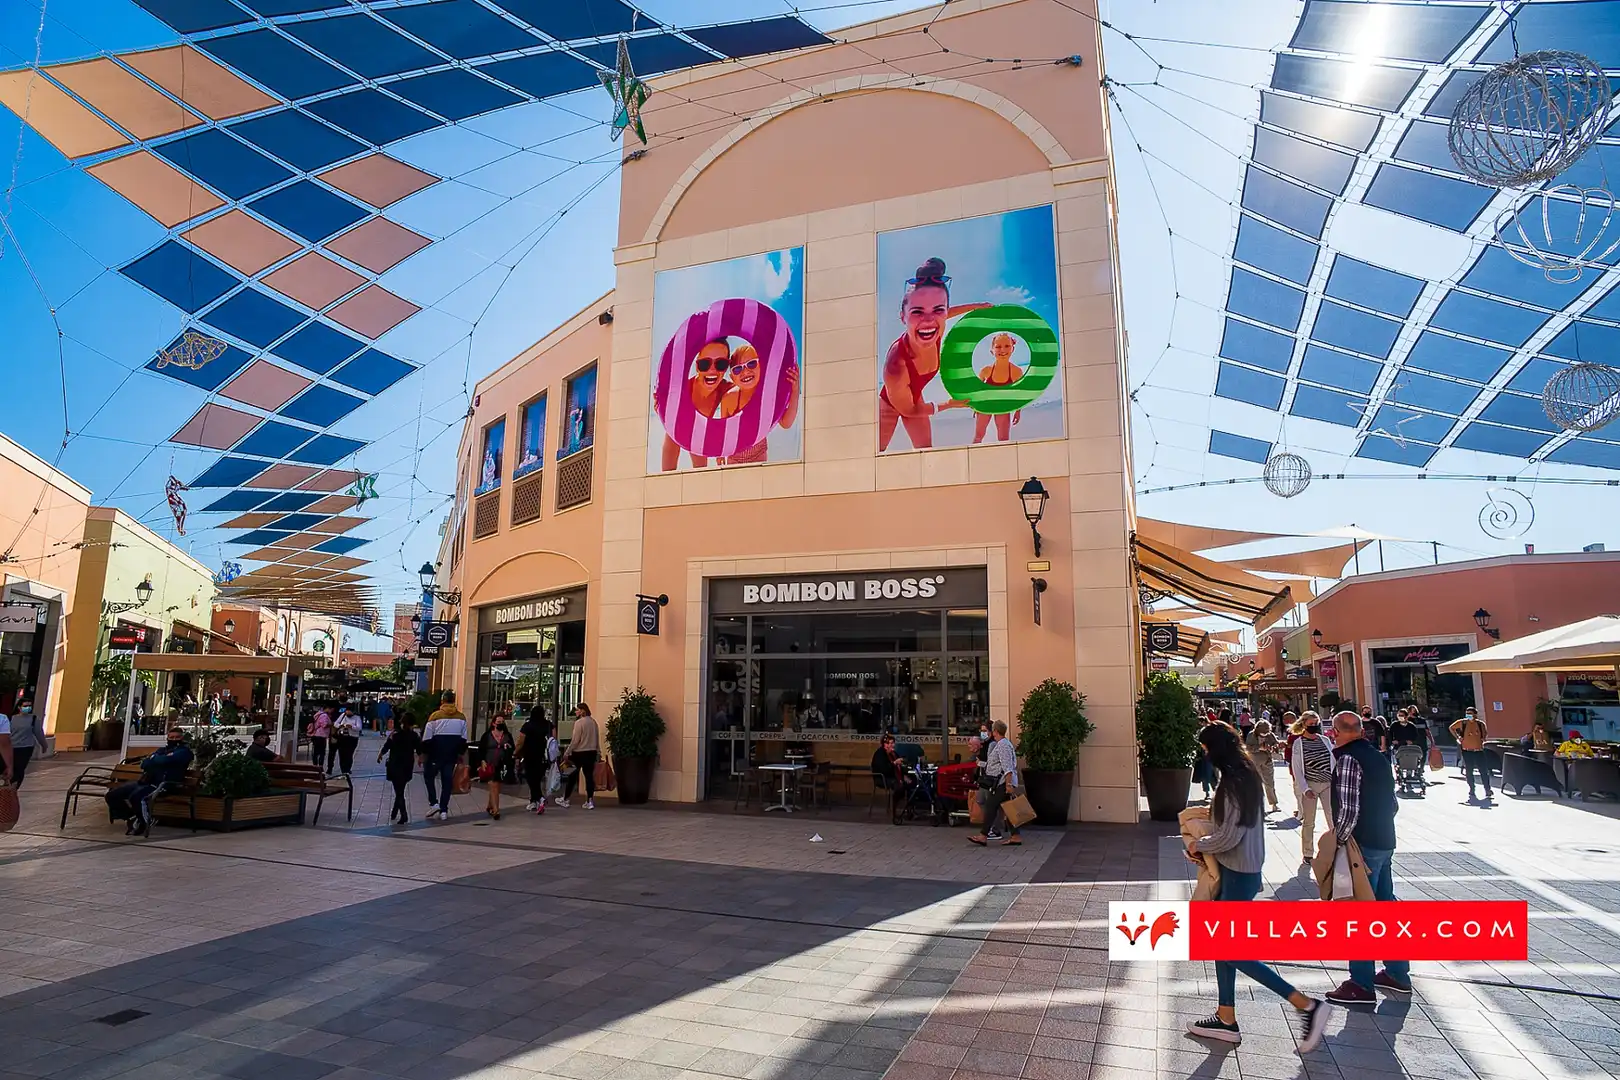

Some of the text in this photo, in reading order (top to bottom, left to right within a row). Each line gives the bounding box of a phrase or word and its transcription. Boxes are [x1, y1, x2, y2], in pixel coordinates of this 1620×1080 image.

[743, 580, 857, 604] BOMBON
[495, 603, 534, 624] BOMBON
[420, 646, 438, 654] VANS
[858, 672, 880, 680] BOSS
[796, 733, 840, 741] FOCACCIAS
